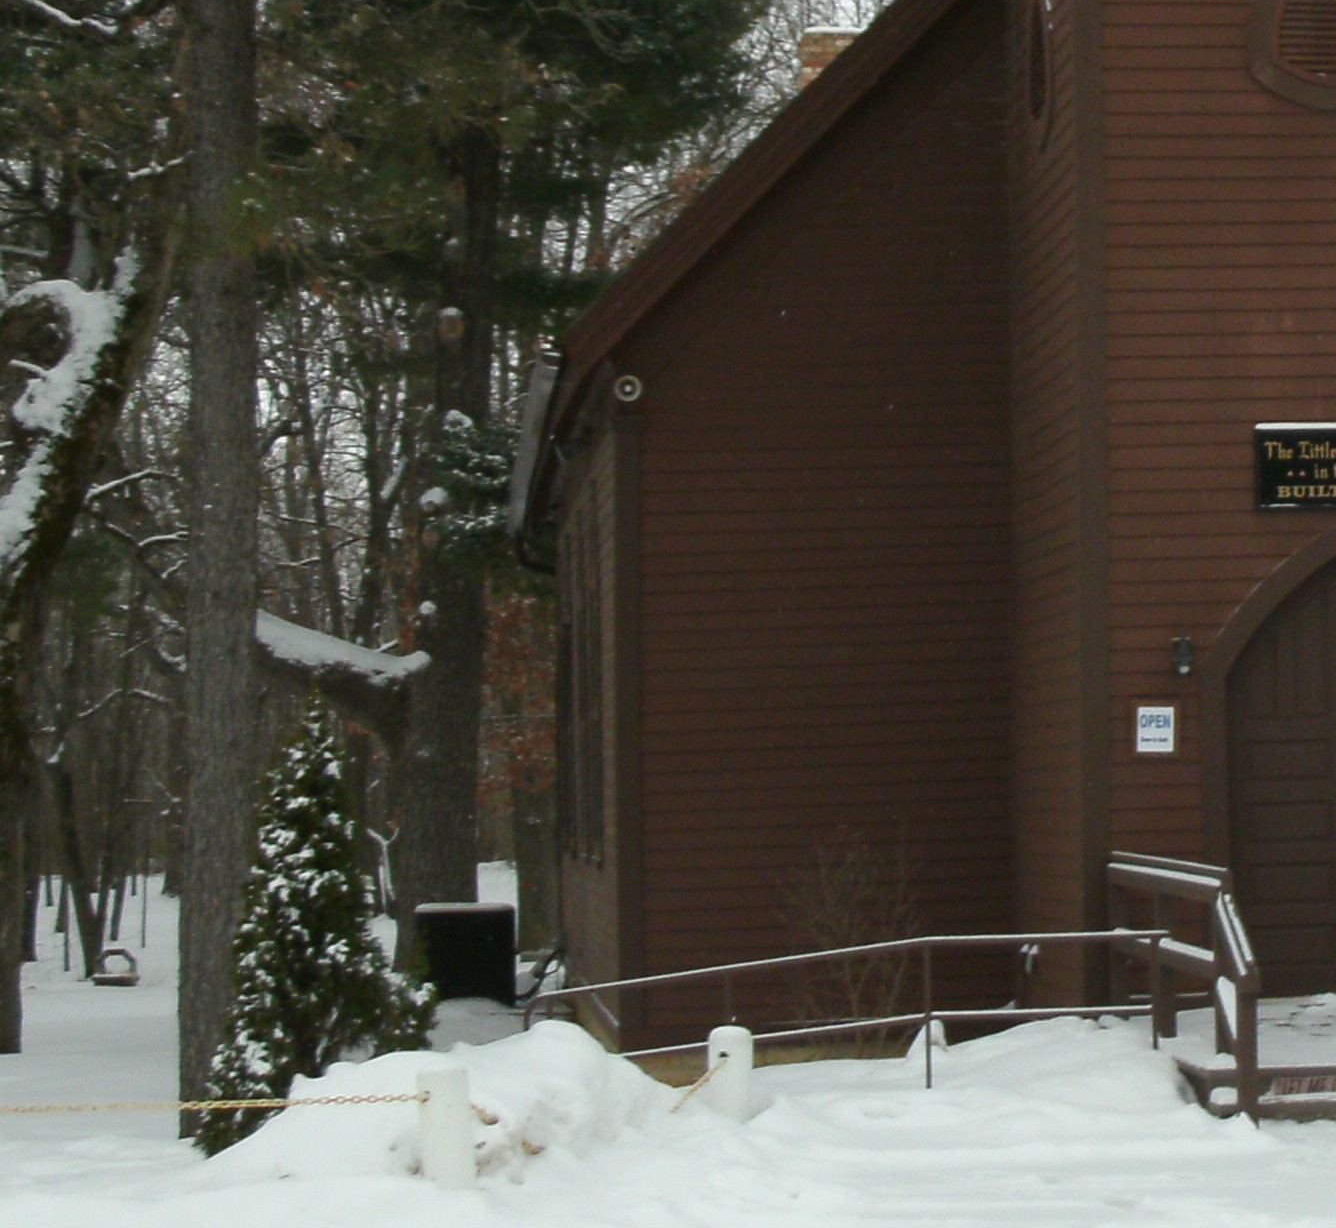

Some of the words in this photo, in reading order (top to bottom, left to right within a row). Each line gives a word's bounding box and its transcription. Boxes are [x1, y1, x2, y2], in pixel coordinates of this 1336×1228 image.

[1264, 441, 1293, 460] The
[1298, 440, 1336, 459] Little
[1314, 463, 1328, 479] in
[1140, 714, 1171, 728] OPEN
